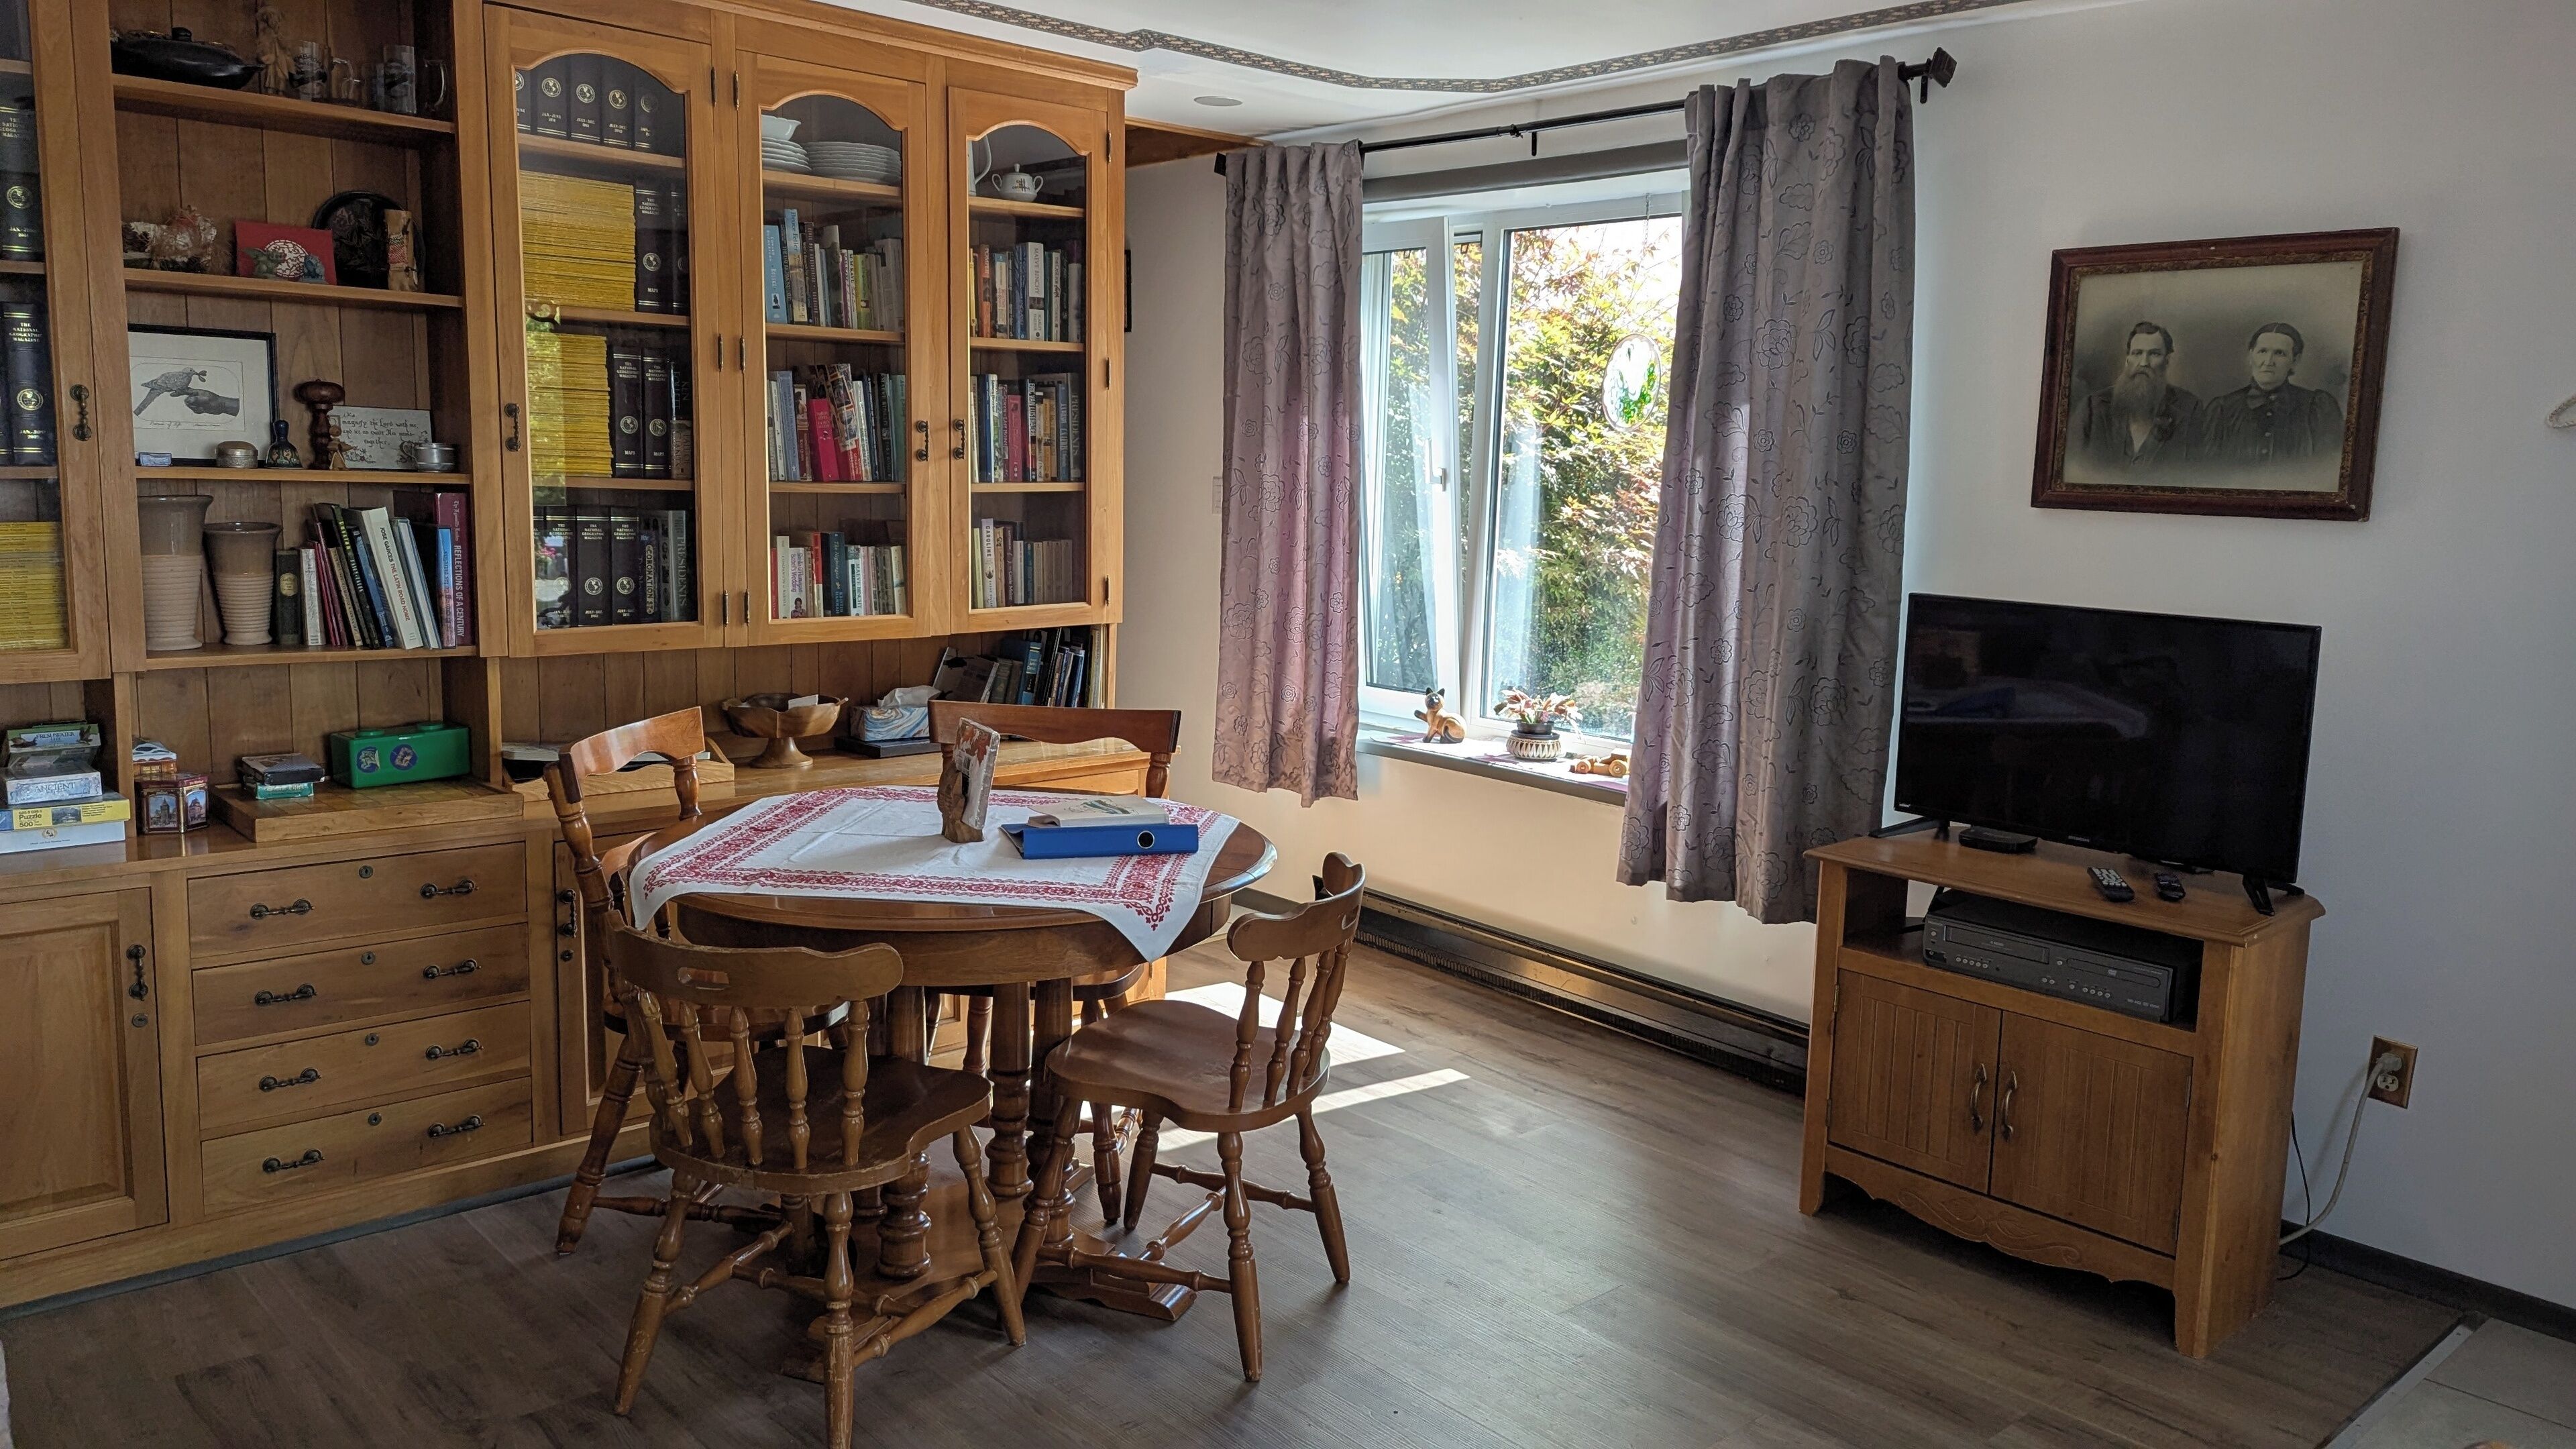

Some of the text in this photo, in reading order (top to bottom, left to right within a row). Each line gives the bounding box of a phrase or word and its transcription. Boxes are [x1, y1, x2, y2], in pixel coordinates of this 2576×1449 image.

[380, 527, 388, 540] JOSE
[384, 541, 394, 562] GARCES
[392, 574, 402, 590] LATIN
[397, 590, 405, 605] ROAD
[401, 605, 411, 621] HOME
[453, 545, 462, 590] REFLECTIONS
[677, 537, 686, 606] PRESIDENTS
[790, 572, 798, 592] Wedding
[455, 592, 463, 600] OF
[455, 607, 464, 637] CENTURY
[34, 782, 76, 792] ANCIENT
